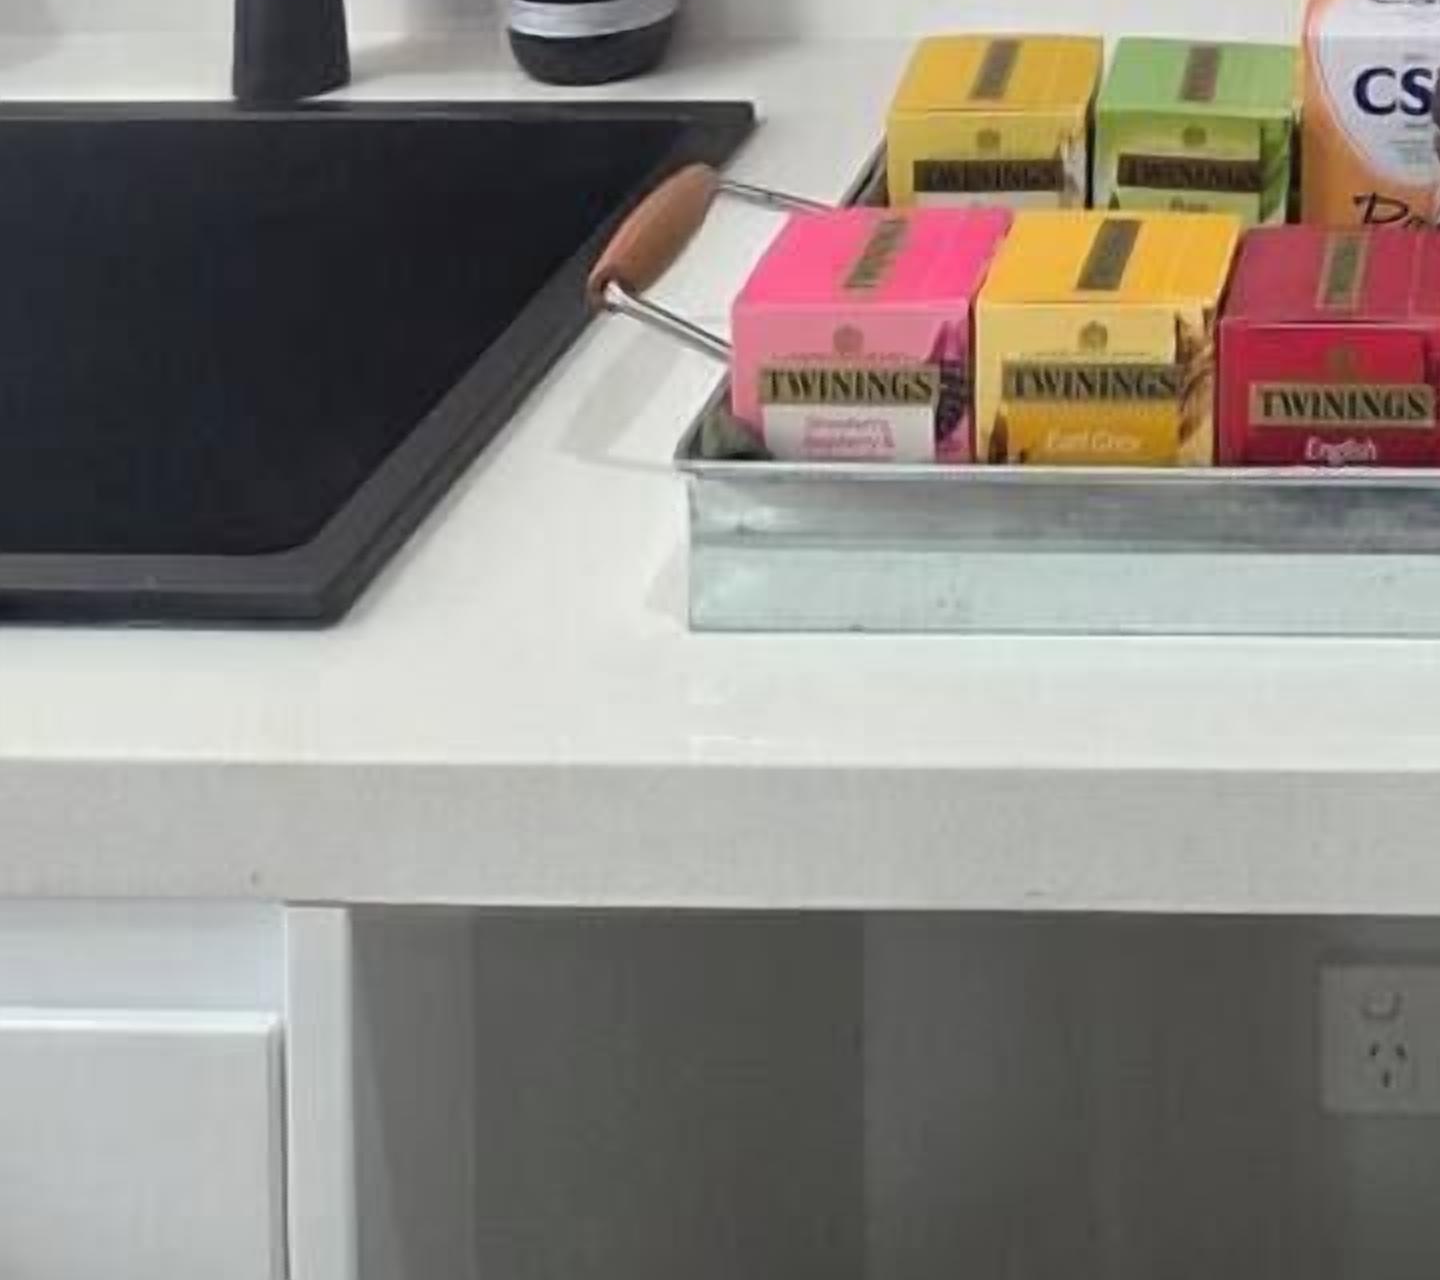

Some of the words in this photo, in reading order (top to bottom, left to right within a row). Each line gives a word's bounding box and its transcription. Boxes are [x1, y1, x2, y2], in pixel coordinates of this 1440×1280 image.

[1354, 67, 1434, 116] CS
[771, 370, 933, 402] TWININGS
[1012, 370, 1177, 399] TWININGS
[1262, 391, 1428, 421] TWININGS
